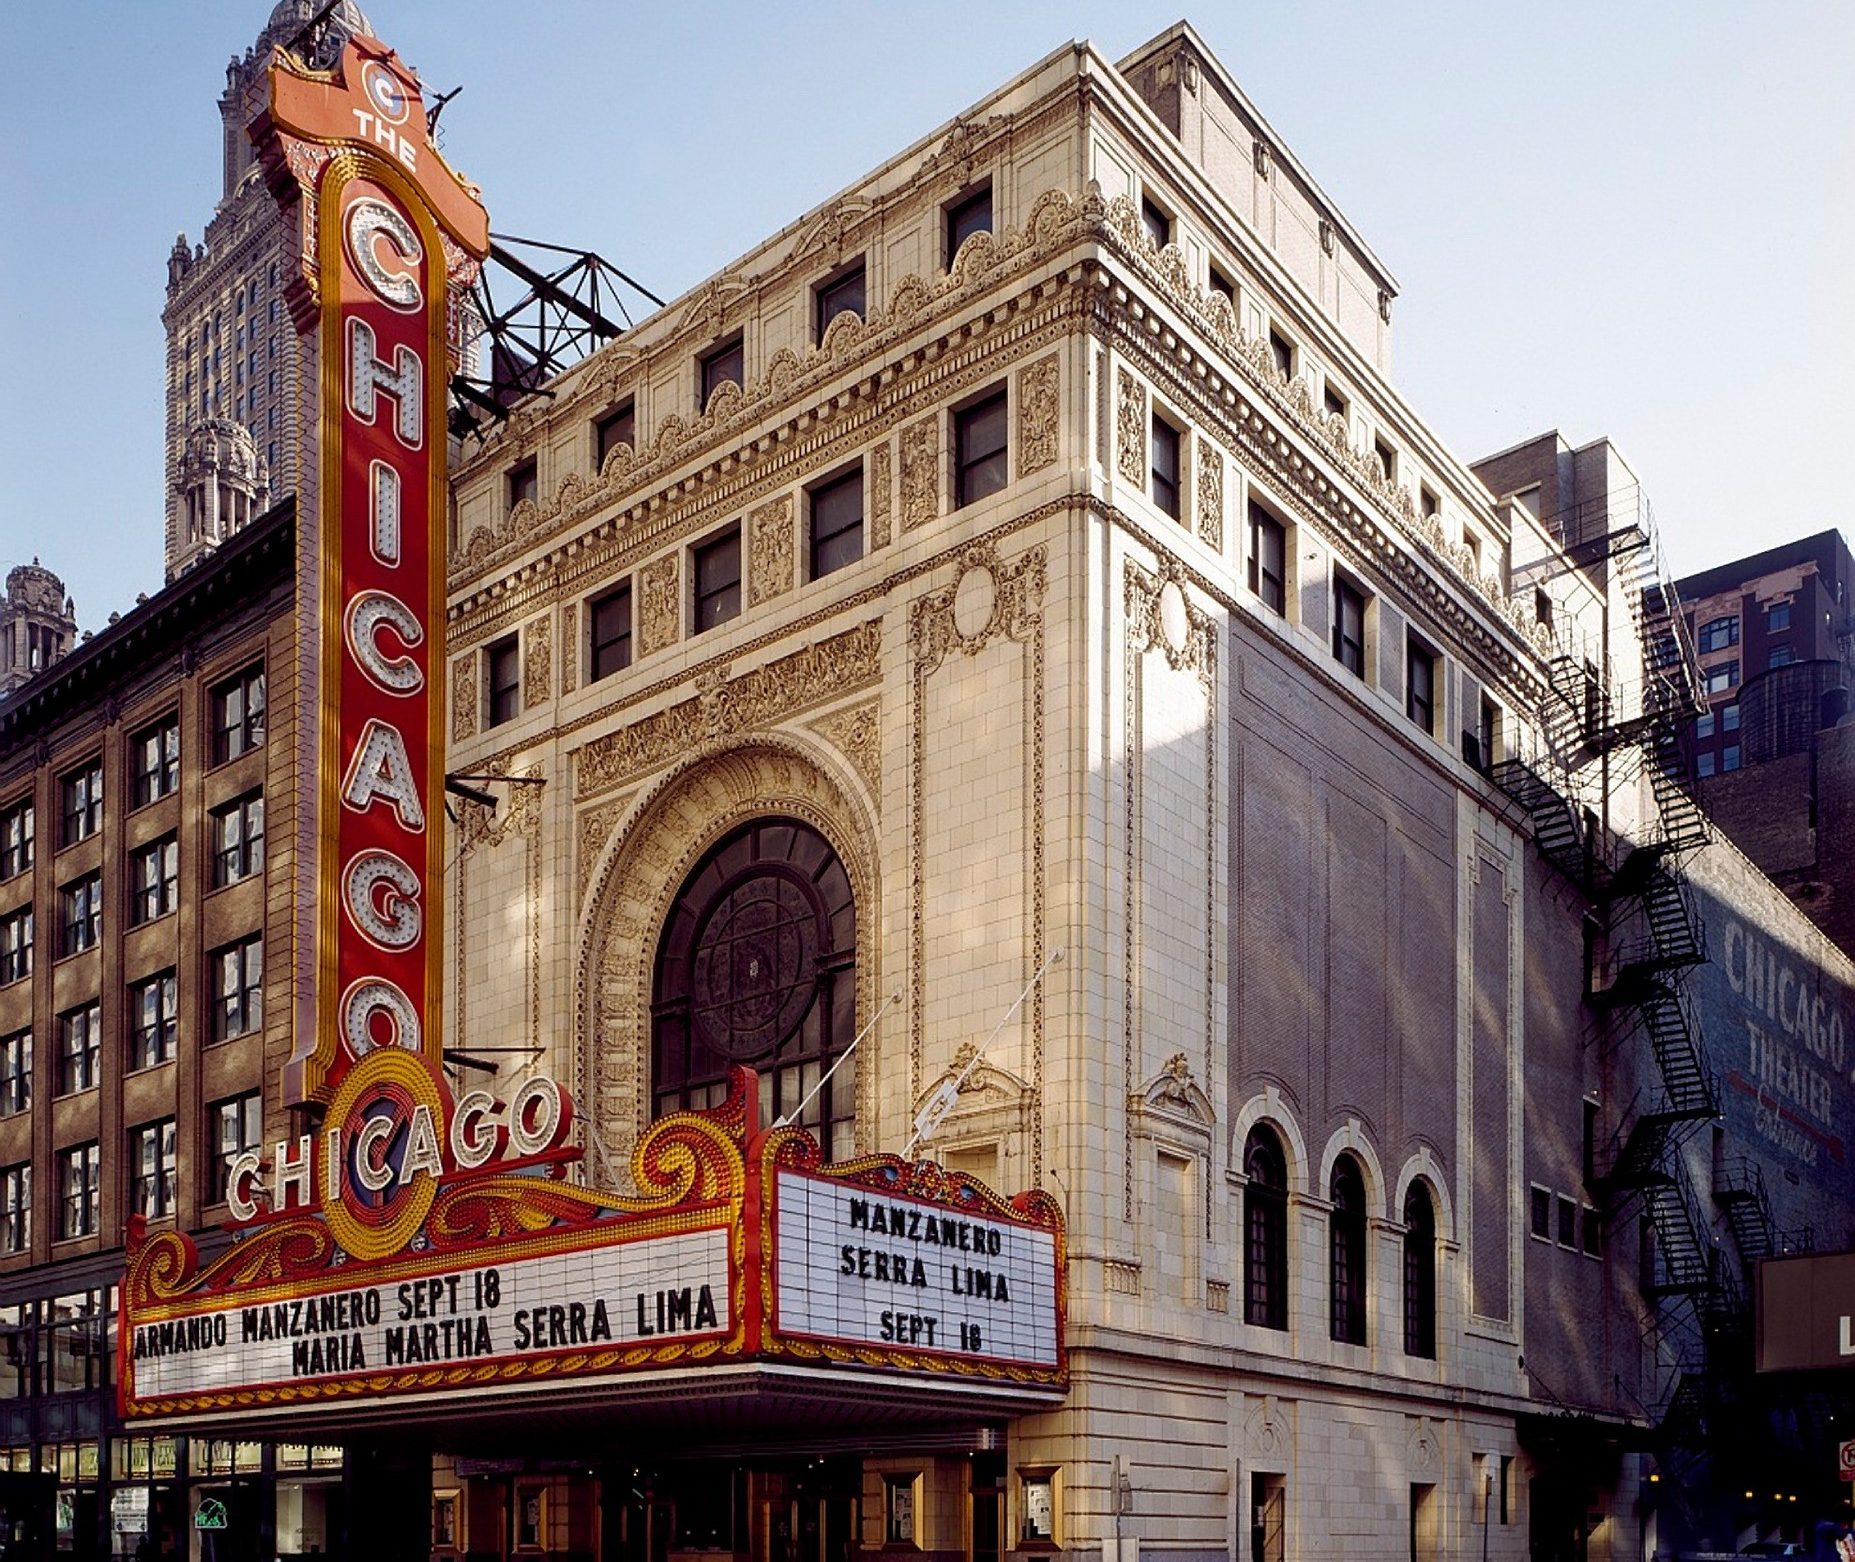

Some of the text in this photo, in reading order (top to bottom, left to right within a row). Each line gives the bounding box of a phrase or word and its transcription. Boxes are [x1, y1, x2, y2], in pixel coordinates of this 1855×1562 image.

[352, 108, 417, 174] THE
[338, 196, 424, 1063] CHICAGO
[1724, 921, 1845, 1073] CHICAGO
[1746, 1019, 1832, 1126] THEATER
[226, 1075, 562, 1222] CHICAGO
[841, 1244, 1010, 1302] SERRA LIMA
[850, 1197, 1001, 1257] MANZANERO
[133, 1268, 501, 1360] ARMANDO MANZANERO SEPT 18
[292, 1284, 718, 1376] MARIA MARTHA SERRA LIMA
[880, 1310, 982, 1352] SEPT 18
